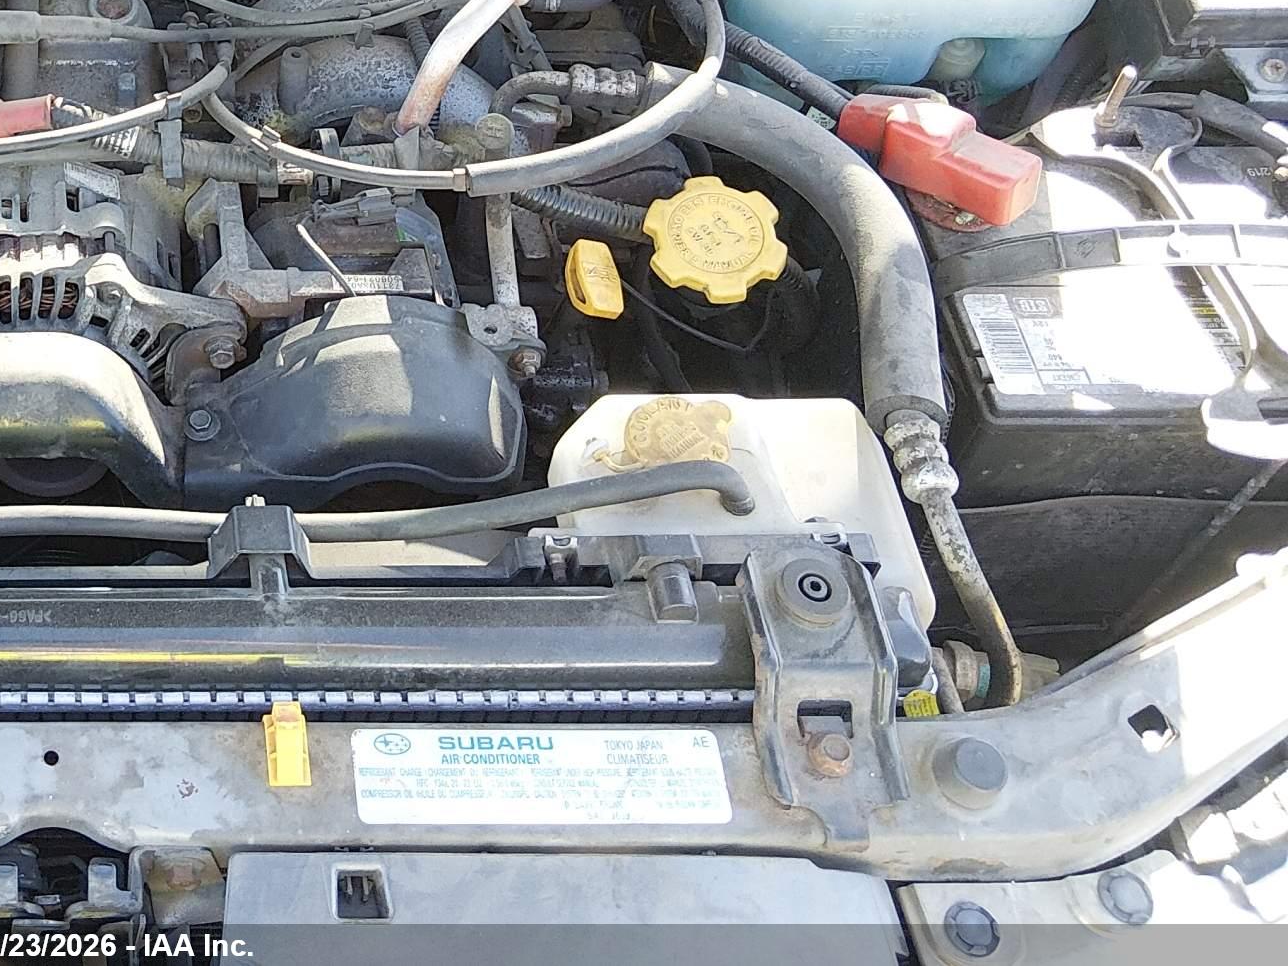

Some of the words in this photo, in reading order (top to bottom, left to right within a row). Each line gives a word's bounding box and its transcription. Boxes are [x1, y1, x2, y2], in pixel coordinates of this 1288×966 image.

[438, 736, 554, 750] SUBARU
[604, 740, 634, 750] TOKYO
[636, 740, 664, 750] JAPAN
[693, 736, 711, 748] AE
[441, 753, 461, 765] AIR
[463, 753, 540, 765] CONDITIONER
[606, 753, 670, 765] CLIMATISEUR
